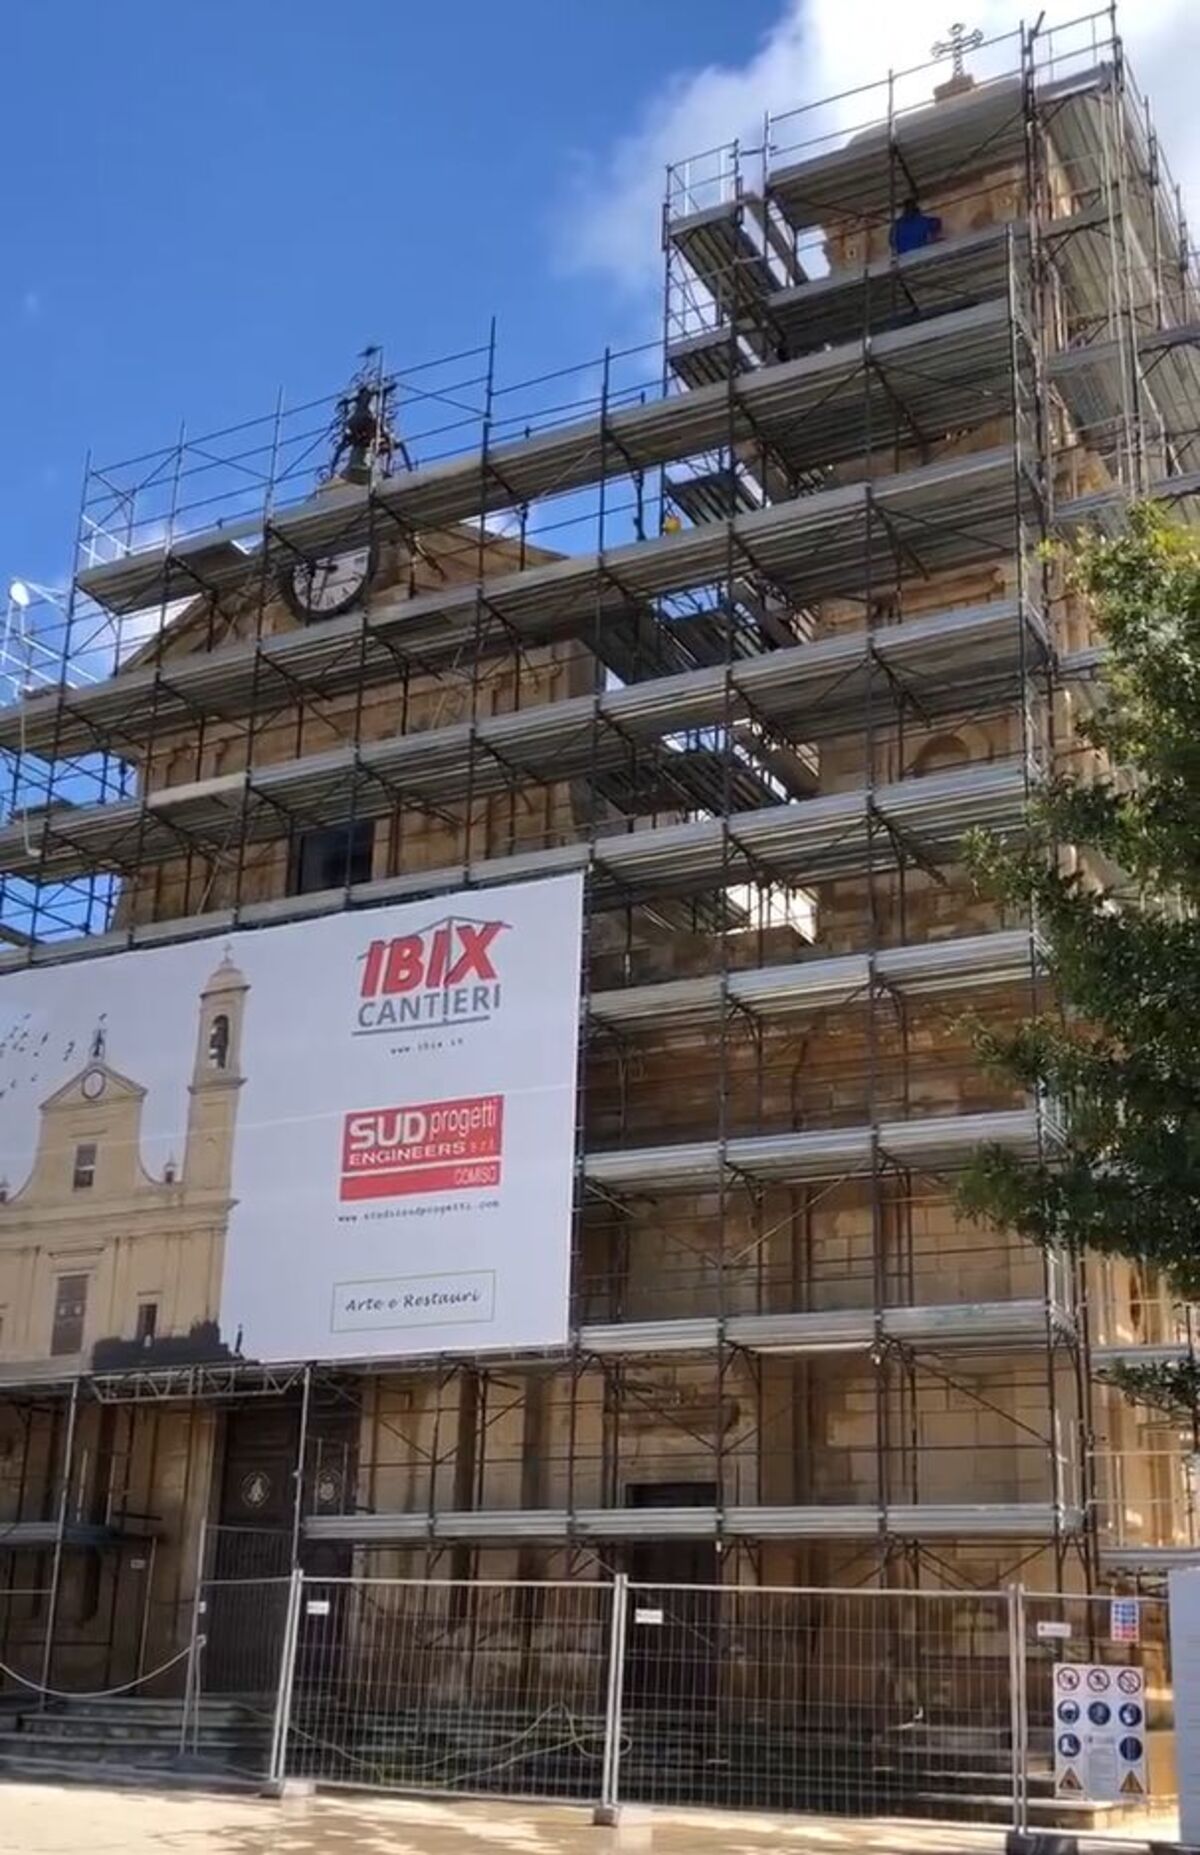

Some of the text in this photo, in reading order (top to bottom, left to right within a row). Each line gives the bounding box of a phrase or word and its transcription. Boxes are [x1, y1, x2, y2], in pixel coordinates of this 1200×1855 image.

[360, 921, 503, 998] IBIX
[357, 983, 502, 1028] CANTIERI
[350, 1098, 497, 1150] SUD progetti
[350, 1141, 467, 1166] ENGINEERS
[345, 1289, 481, 1312] Arte e Restauri
